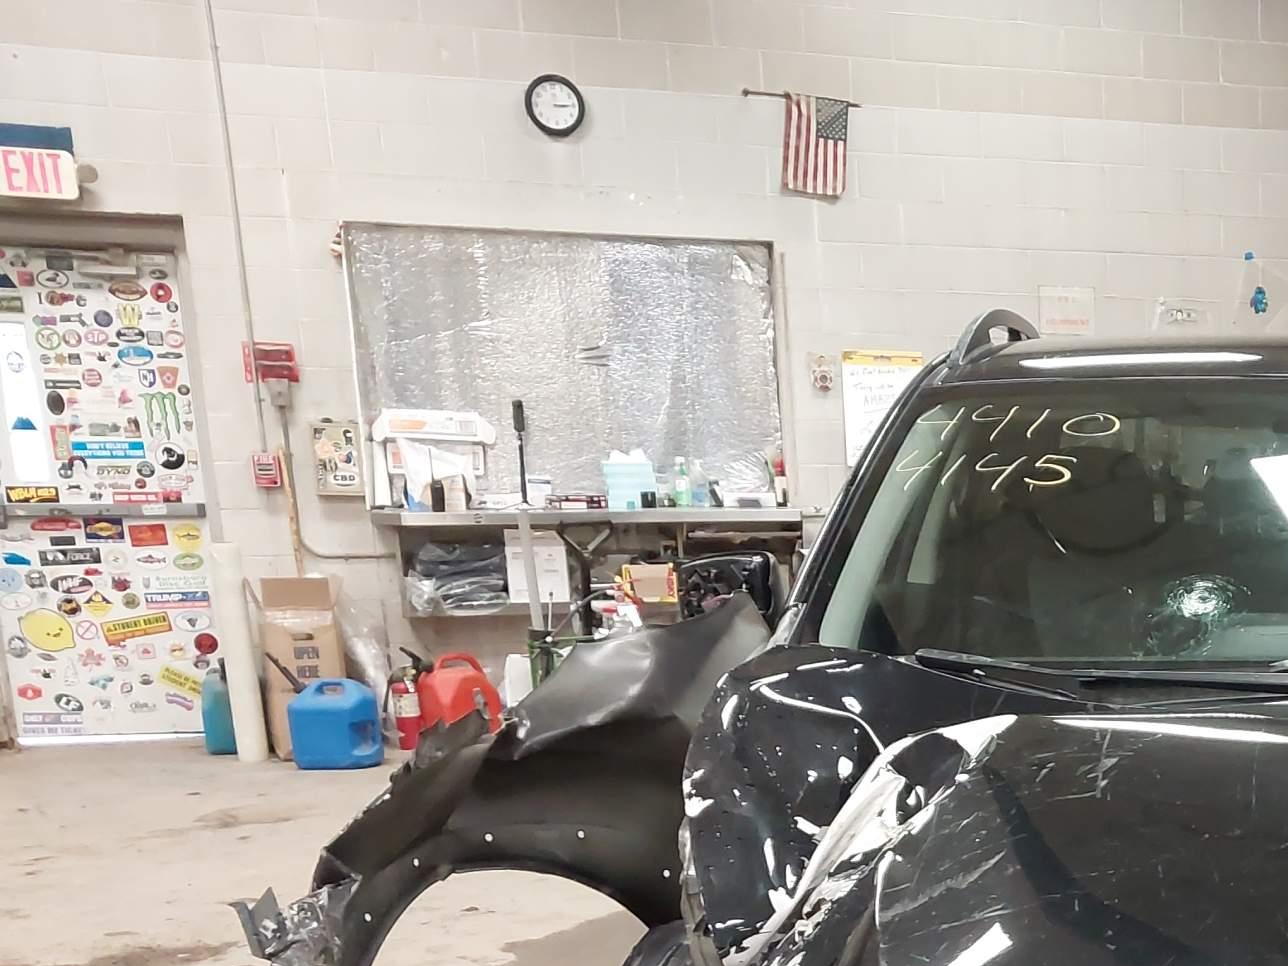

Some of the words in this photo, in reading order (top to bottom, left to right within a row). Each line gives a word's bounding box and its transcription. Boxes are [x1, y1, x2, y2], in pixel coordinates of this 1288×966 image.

[2, 150, 63, 194] EXIT
[145, 592, 183, 603] TRUMP
[112, 619, 141, 632] STUDENT
[142, 615, 168, 626] DRIVER
